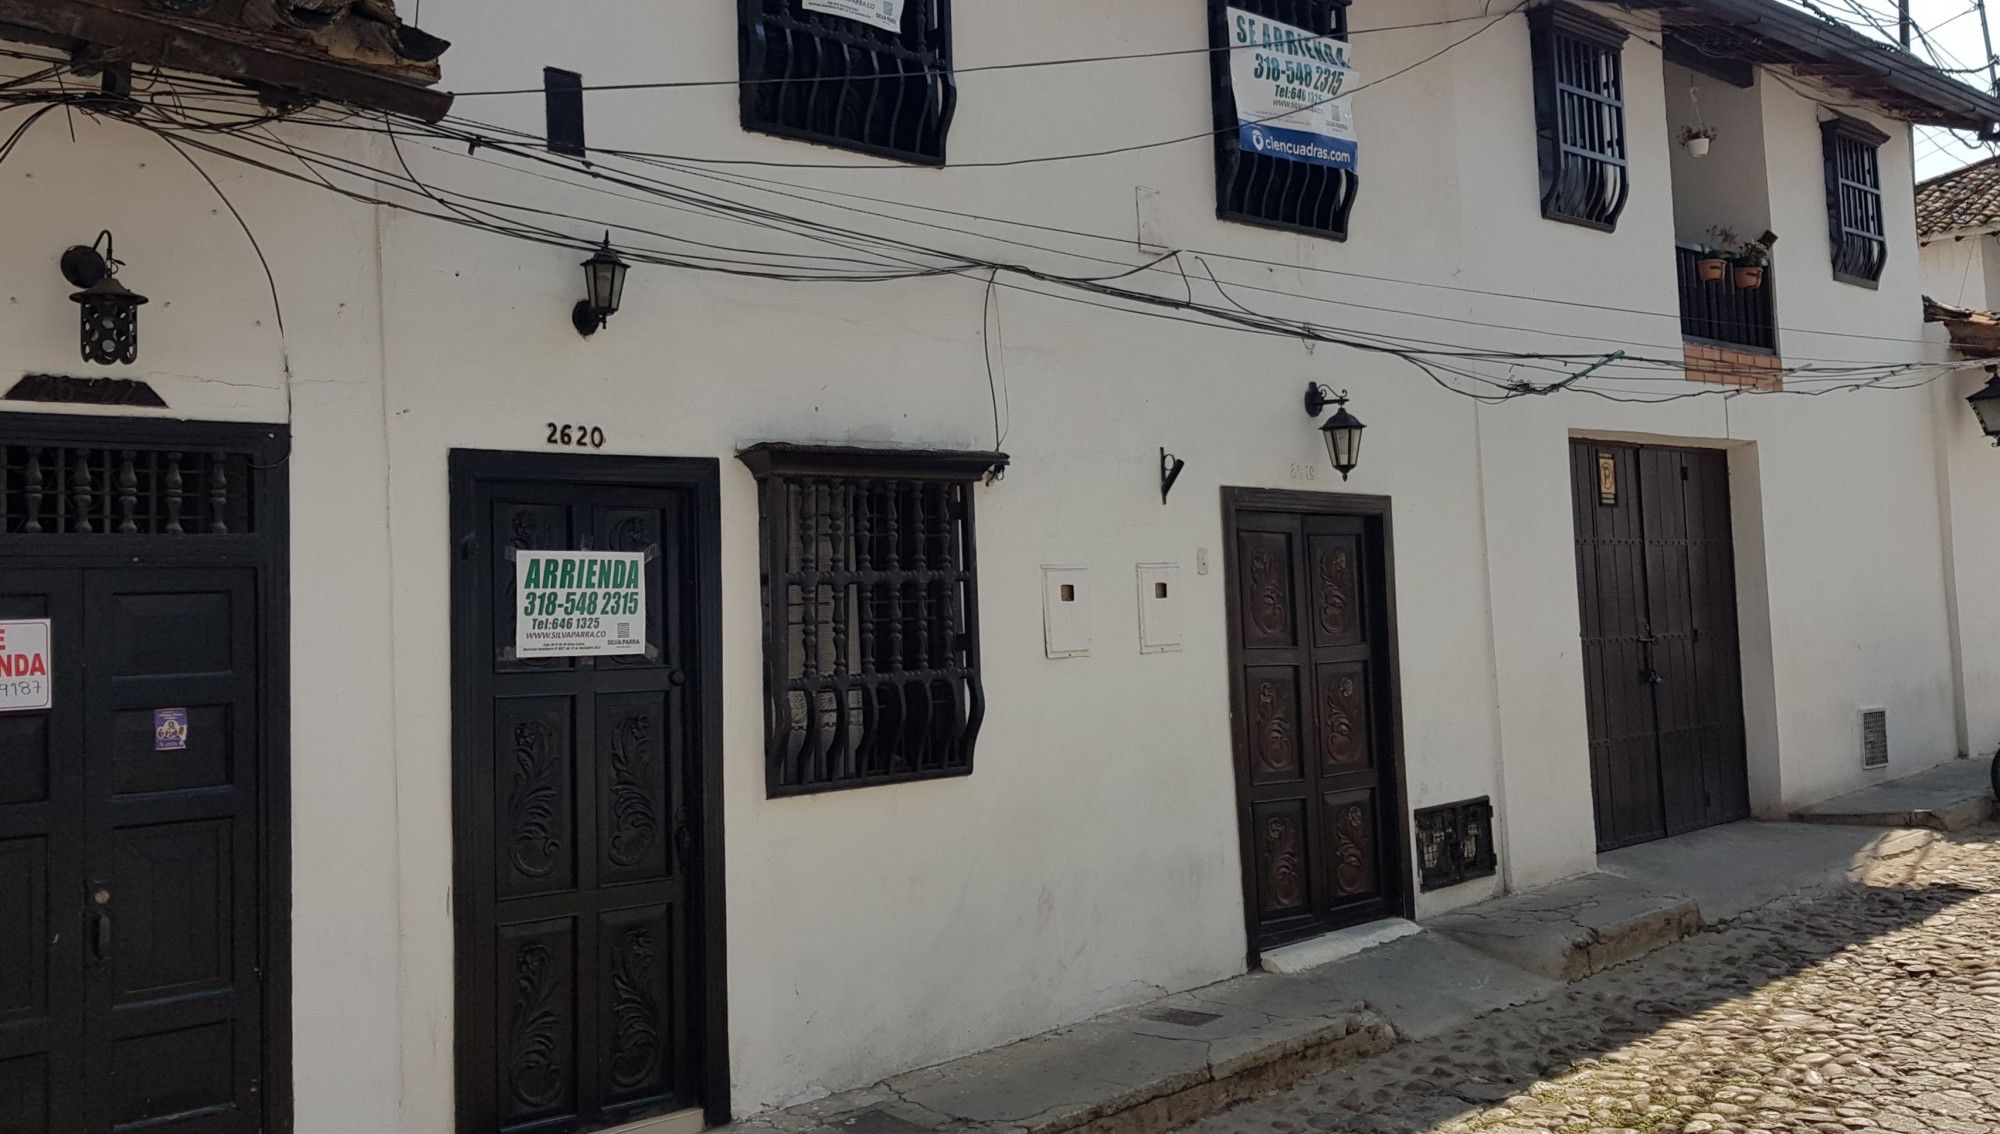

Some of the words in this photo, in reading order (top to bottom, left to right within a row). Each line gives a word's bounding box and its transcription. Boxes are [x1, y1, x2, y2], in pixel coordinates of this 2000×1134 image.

[1236, 15, 1257, 45] SE
[1262, 22, 1351, 69] ARRIENDA
[1254, 53, 1312, 88] 318-548
[1313, 65, 1344, 96] 2315
[1275, 84, 1306, 101] Tel:646
[1265, 136, 1351, 163] ciencuadras.com
[547, 422, 604, 448] 2620
[524, 558, 639, 589] ARRIENDA
[523, 591, 599, 616] 318-548
[600, 591, 639, 615] 2315
[526, 630, 606, 639] WWW.SILVAPARRA.CO
[532, 617, 574, 630] Tel:646
[575, 617, 600, 629] 1325
